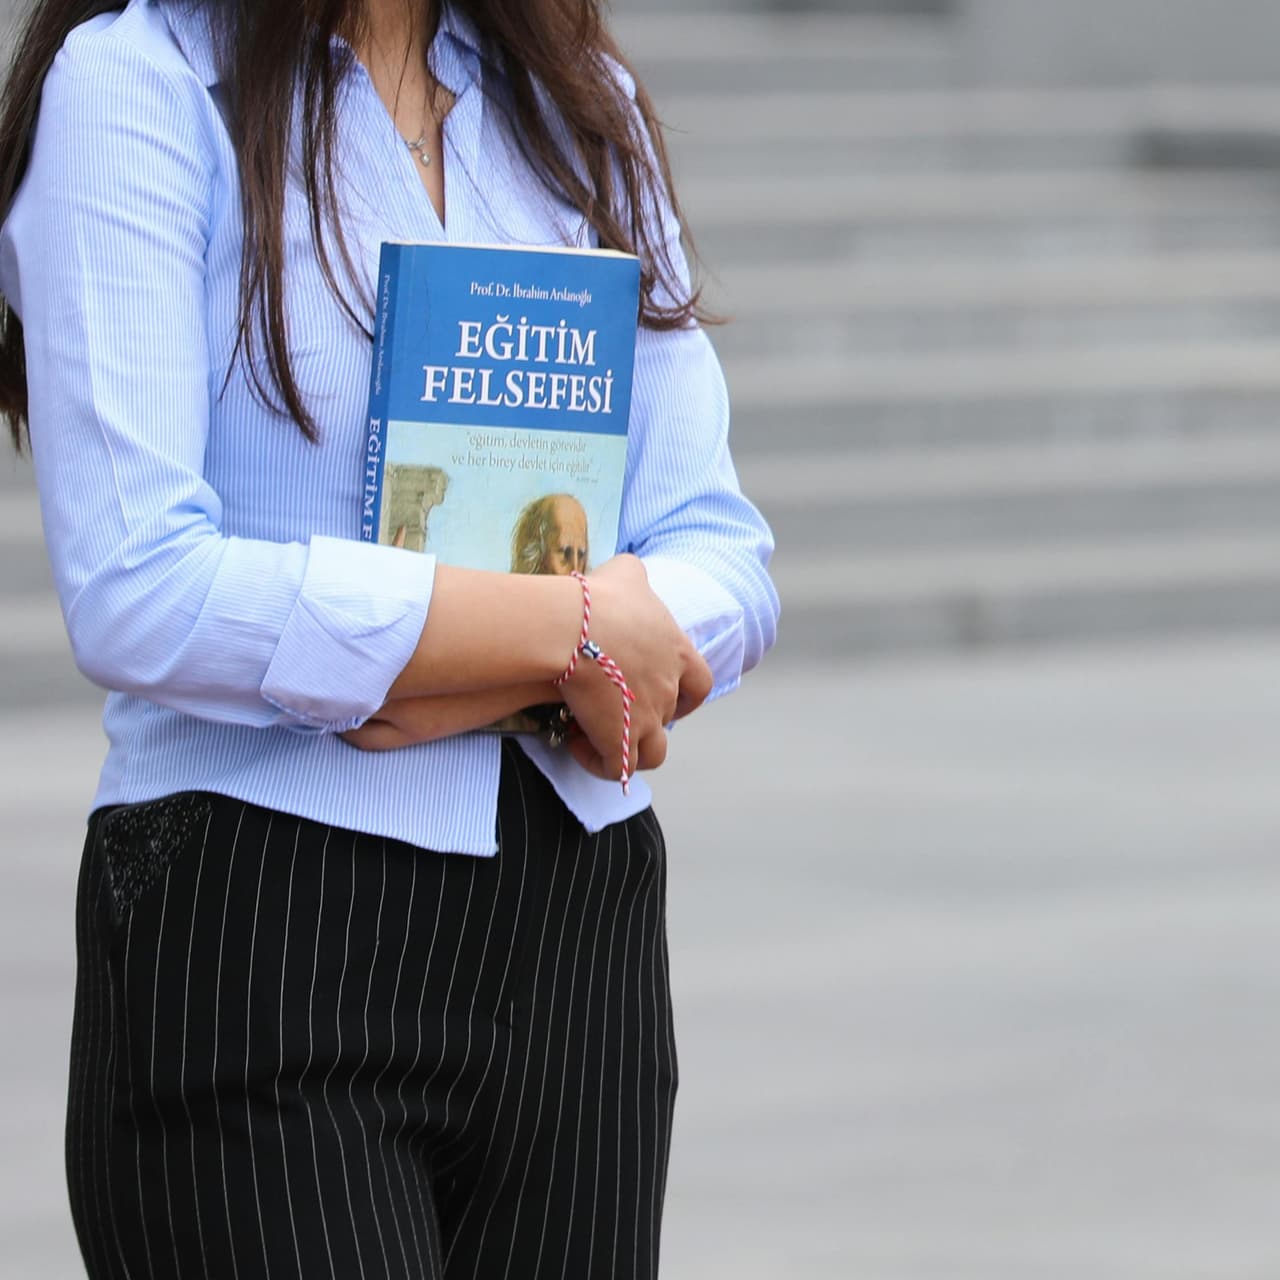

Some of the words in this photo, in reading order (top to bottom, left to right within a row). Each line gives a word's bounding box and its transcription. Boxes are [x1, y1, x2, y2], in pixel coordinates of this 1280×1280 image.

[470, 282, 494, 297] Prof.
[496, 283, 511, 297] Dr.
[455, 314, 597, 366] EĞİTİM
[420, 365, 614, 413] FELSEFESİ
[510, 432, 549, 450] devletin
[363, 417, 381, 518] EĞİTİM
[452, 455, 465, 466] ve
[467, 451, 487, 467] her
[489, 452, 515, 472] birey
[518, 453, 547, 471] devlet
